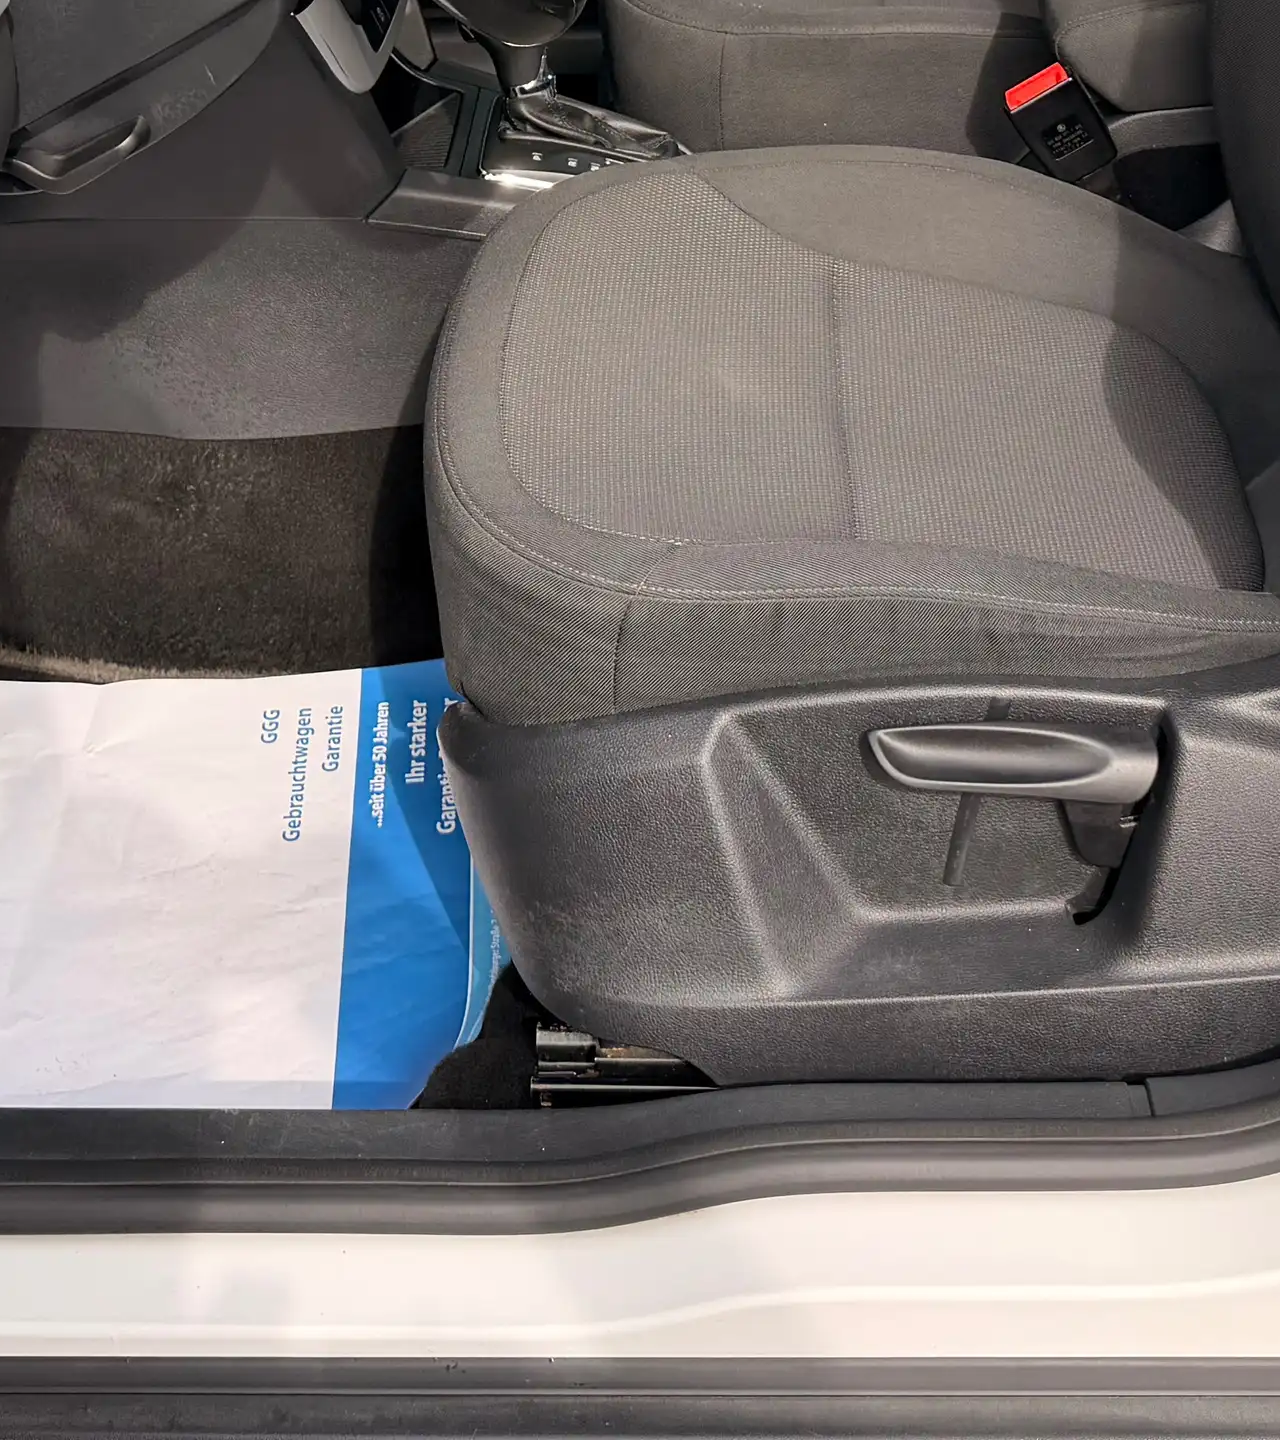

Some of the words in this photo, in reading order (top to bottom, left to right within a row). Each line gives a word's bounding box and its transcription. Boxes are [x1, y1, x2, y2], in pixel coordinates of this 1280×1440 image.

[261, 709, 280, 744] GGG
[322, 704, 344, 772] Garantie
[373, 701, 389, 745] Jahren
[407, 700, 427, 758] starker
[371, 746, 387, 761] 50
[405, 760, 425, 784] Ihr
[282, 707, 315, 842] Gebrauchtwagen
[369, 762, 386, 791] über
